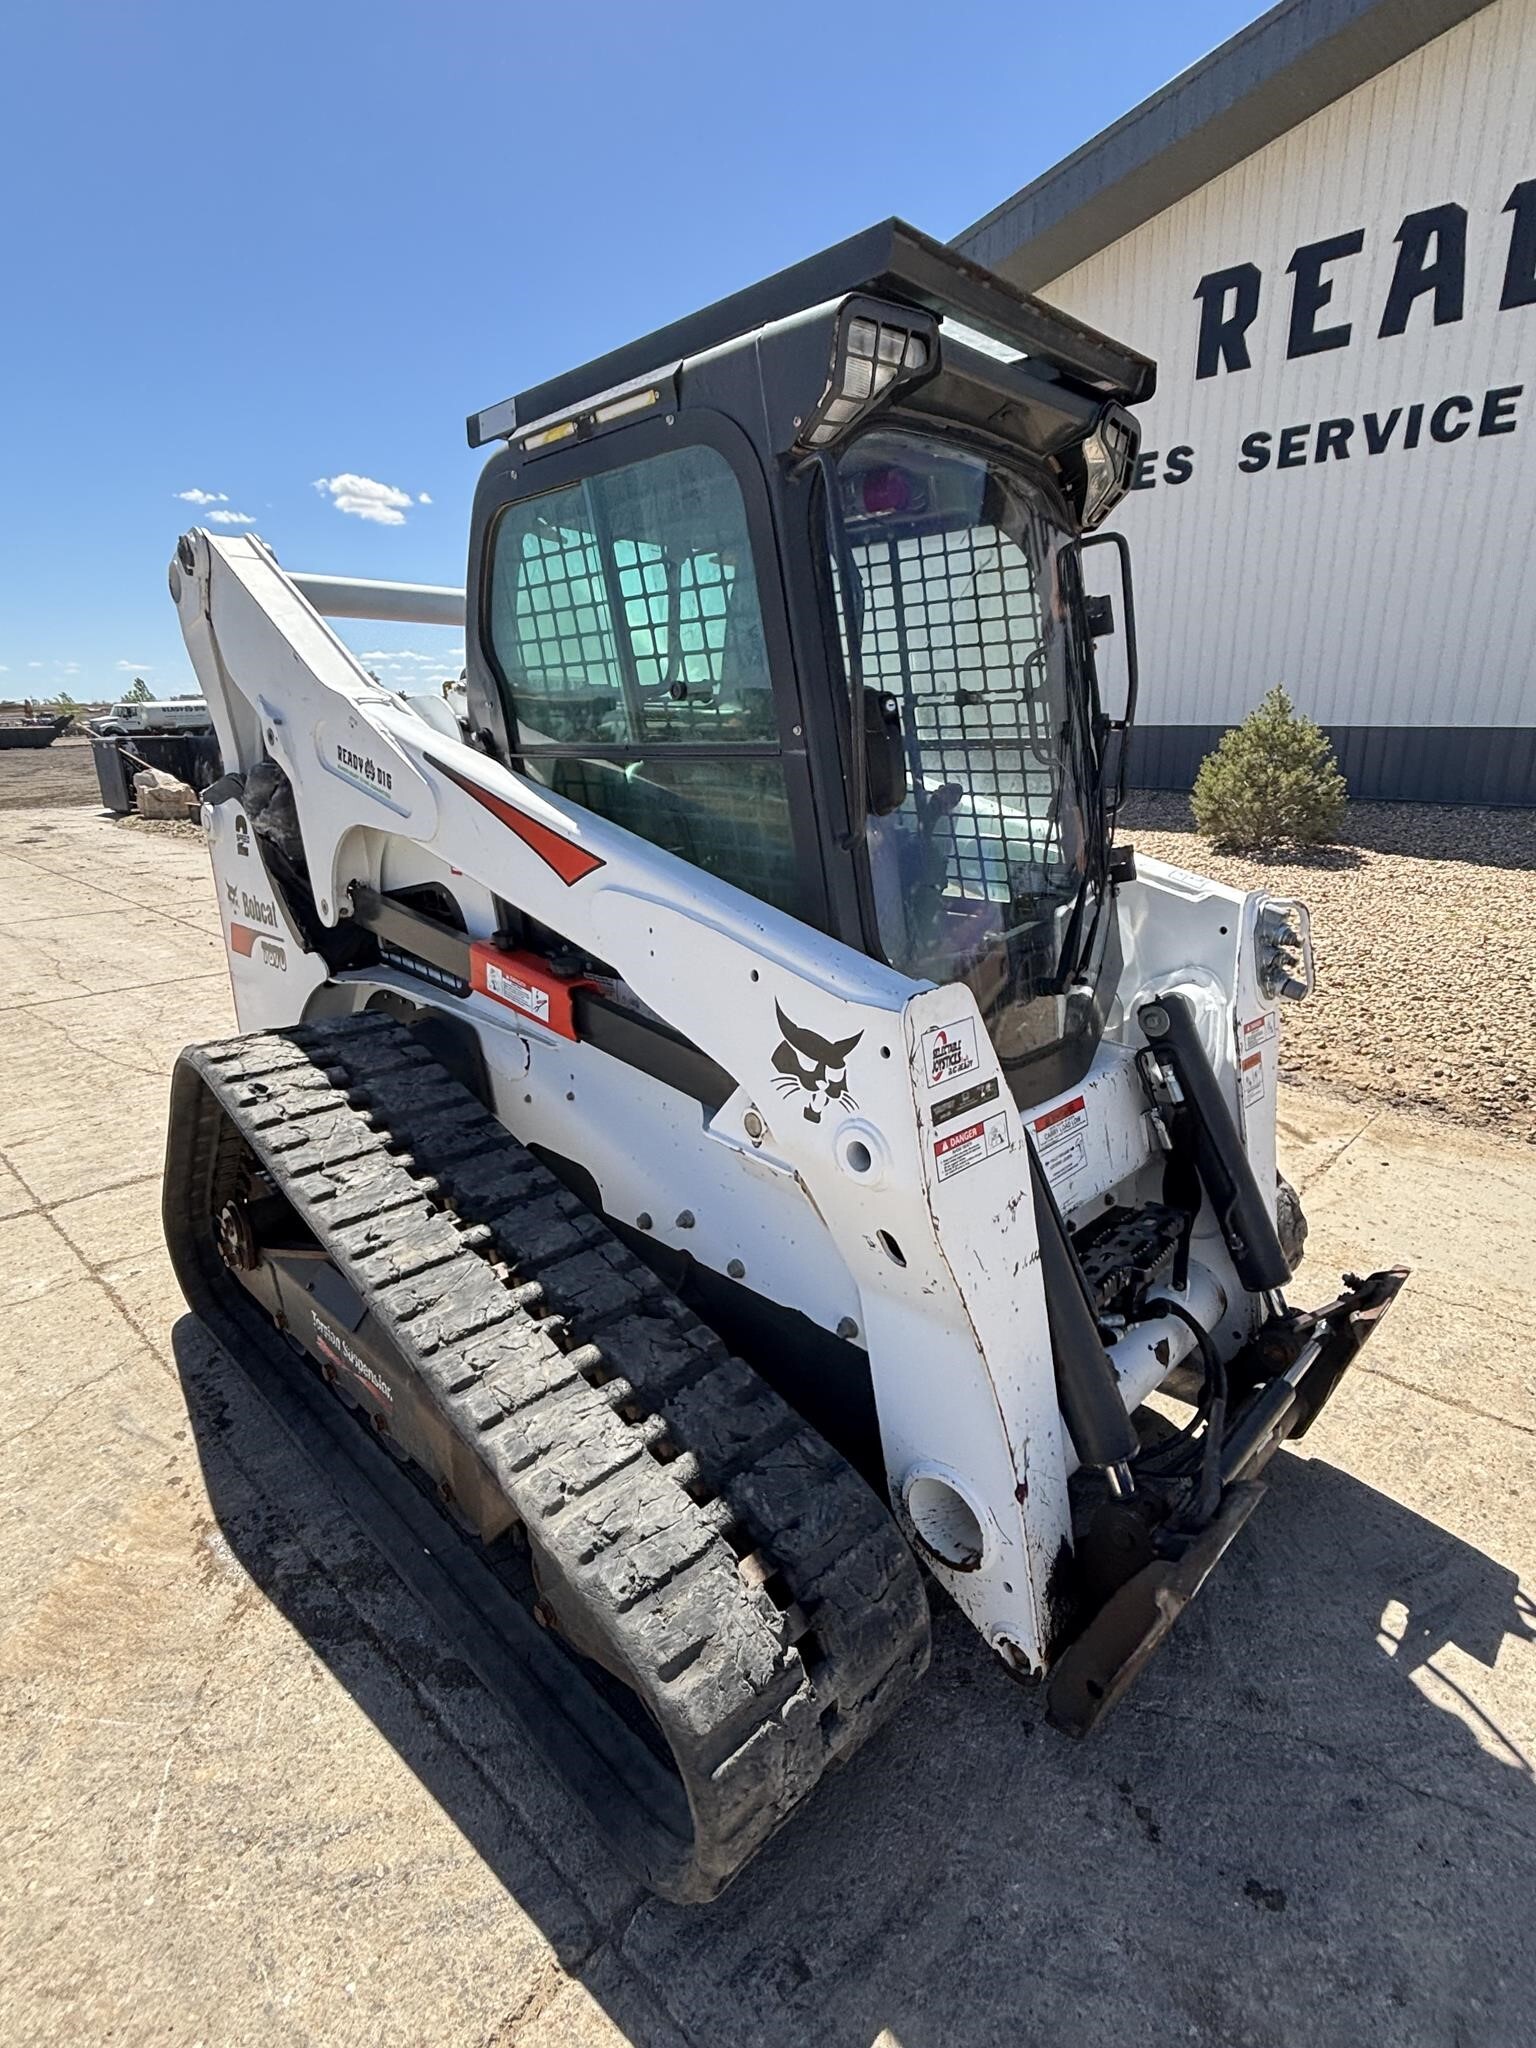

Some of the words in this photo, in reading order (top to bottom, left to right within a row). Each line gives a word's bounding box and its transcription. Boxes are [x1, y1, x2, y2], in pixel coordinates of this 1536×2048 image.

[1129, 445, 1194, 490] ES
[1238, 385, 1523, 473] SERVICE
[337, 745, 364, 773] READY
[242, 891, 278, 928] Bobcat
[950, 1127, 978, 1147] DANGER
